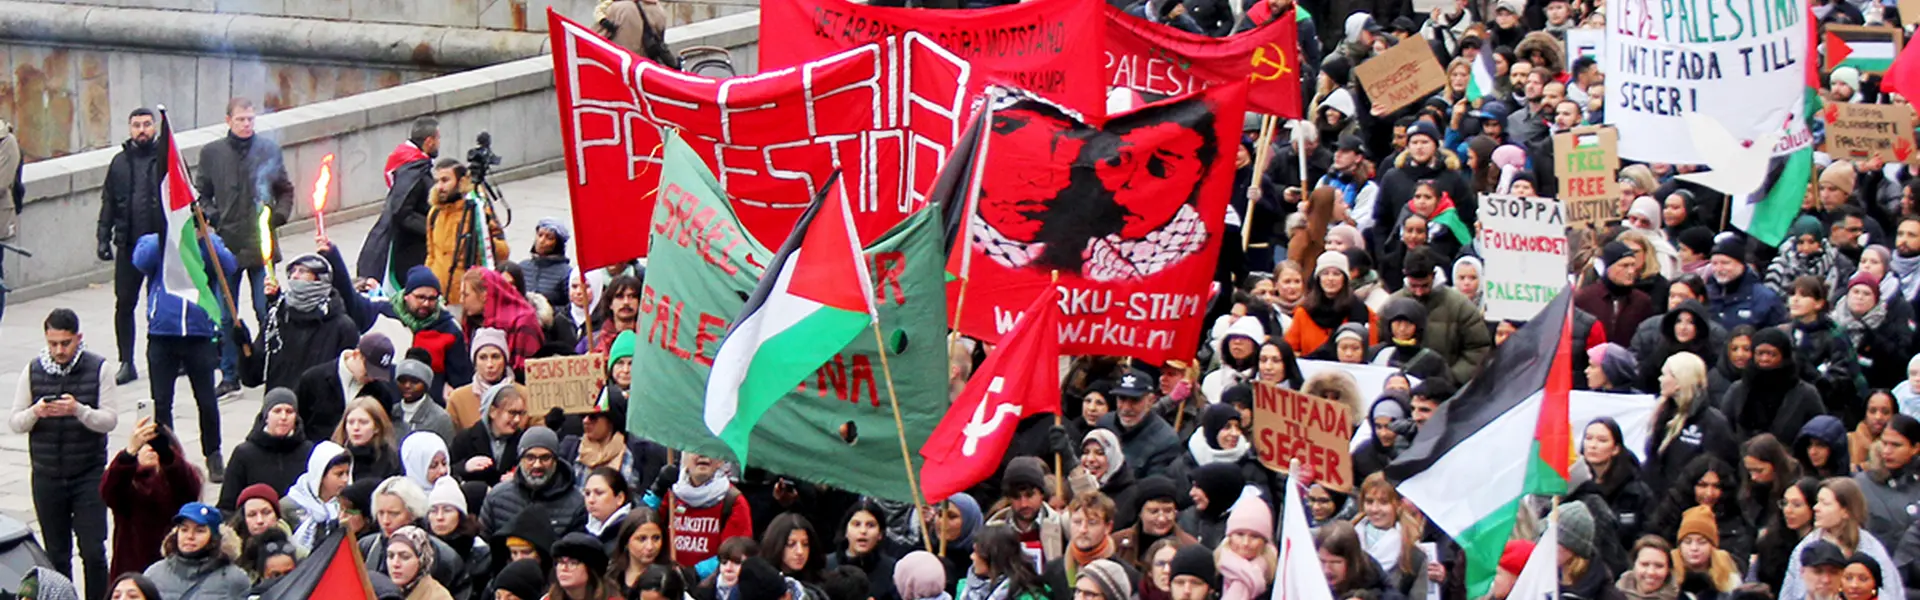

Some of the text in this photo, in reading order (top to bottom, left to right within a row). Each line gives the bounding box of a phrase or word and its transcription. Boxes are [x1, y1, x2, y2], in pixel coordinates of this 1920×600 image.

[1620, 37, 1796, 80] INTIFADA TILL
[561, 20, 971, 147] BEFRIA
[573, 106, 948, 213] PAESTINA
[1567, 151, 1606, 172] FREE
[1568, 176, 1606, 197] FREE
[1487, 198, 1563, 225] STOPPA
[1566, 199, 1621, 223] ALESTINE
[567, 358, 590, 377] FOR
[1253, 381, 1349, 441] INTIFADA
[1260, 428, 1344, 486] SEGER
